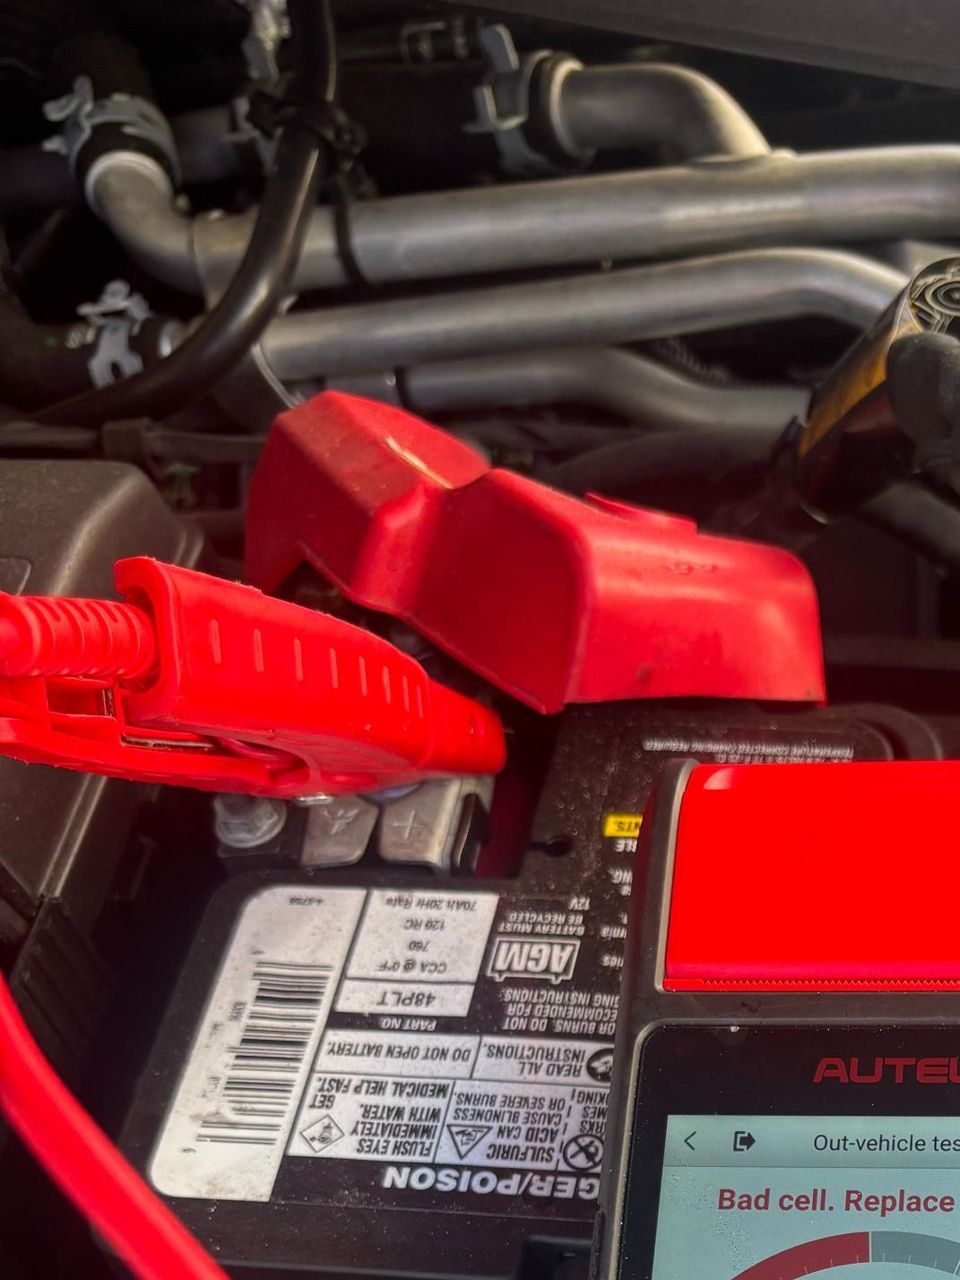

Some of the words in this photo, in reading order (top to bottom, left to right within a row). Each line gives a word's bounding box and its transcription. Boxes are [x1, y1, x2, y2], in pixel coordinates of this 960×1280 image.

[385, 897, 414, 909] Rate
[415, 898, 444, 910] 20Hr
[446, 899, 477, 911] 70Ah
[568, 897, 590, 910] 12V
[403, 918, 423, 931] RC
[425, 919, 445, 931] 120
[497, 921, 533, 933] MUST
[535, 923, 585, 937] BATTERY
[407, 940, 430, 952] 760
[493, 941, 575, 973] AGM
[403, 959, 417, 973] @
[421, 961, 448, 974] CCA
[375, 991, 436, 1007] 48PLT
[507, 1003, 533, 1016] FOR
[379, 1017, 402, 1030] NO.
[403, 1018, 437, 1032] PART
[501, 1016, 528, 1031] NOT
[528, 1018, 549, 1032] DO
[599, 1021, 616, 1035] OR
[326, 1041, 384, 1058] BATTERY.
[385, 1045, 420, 1059] OPEN
[421, 1046, 450, 1061] NOT
[452, 1048, 470, 1062] DO
[482, 1043, 586, 1063] INSTRUCTIONS.
[518, 1061, 544, 1076] ALL
[546, 1062, 583, 1078] READ
[316, 1076, 352, 1095] FAST.
[354, 1079, 389, 1096] HELP
[391, 1081, 450, 1099] MEDICAL
[309, 1094, 336, 1110] GET
[452, 1091, 498, 1107] BURNS.
[500, 1094, 546, 1109] SEVERE
[547, 1097, 566, 1110] OR
[359, 1103, 406, 1121] WATER.
[407, 1107, 442, 1123] WITH
[452, 1108, 521, 1124] BLINDNESS
[523, 1111, 562, 1127] CAUSE
[350, 1120, 438, 1140] IMMEDIATELY
[496, 1124, 522, 1139] CAN
[524, 1126, 559, 1143] ACID
[355, 1138, 392, 1155] EYES
[389, 1140, 434, 1157] FLUSH
[813, 1134, 926, 1152] Out-vehicle
[485, 1143, 556, 1162] SULFURIC
[717, 1188, 771, 1212] Bad
[778, 1189, 834, 1213] cell.
[844, 1190, 955, 1218] Replace
